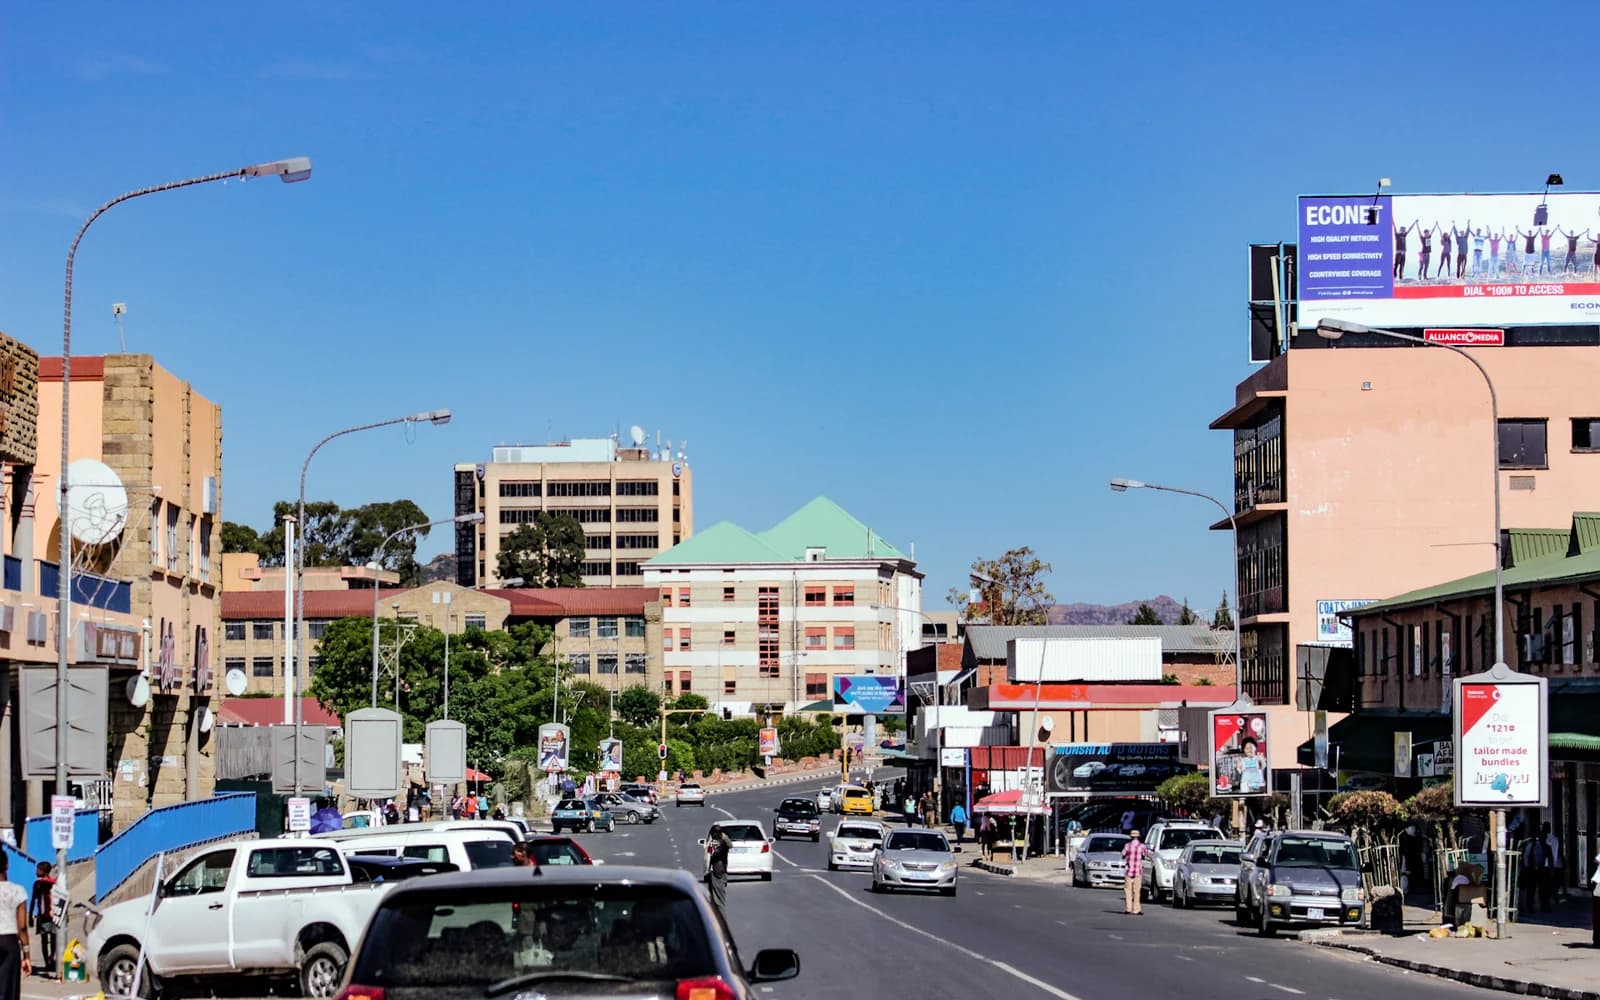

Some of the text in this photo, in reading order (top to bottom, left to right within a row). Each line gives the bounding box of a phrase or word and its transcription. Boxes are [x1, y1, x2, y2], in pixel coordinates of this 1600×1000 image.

[1306, 205, 1383, 226] ECONET
[1326, 235, 1350, 243] QUALITY
[1350, 234, 1379, 242] NETWORK
[1307, 253, 1322, 261] HIGH
[1341, 252, 1383, 260] CONNECTIVITY
[1309, 270, 1350, 279] COUNTRYWIDE
[1463, 286, 1485, 296] DIAL
[1514, 285, 1527, 295] TO
[1528, 284, 1564, 295] ACCESS
[1428, 333, 1499, 341] ALLIANCE MEDIA
[1318, 601, 1347, 614] COATS
[1473, 746, 1528, 756] tailor made
[1481, 757, 1520, 767] bundles
